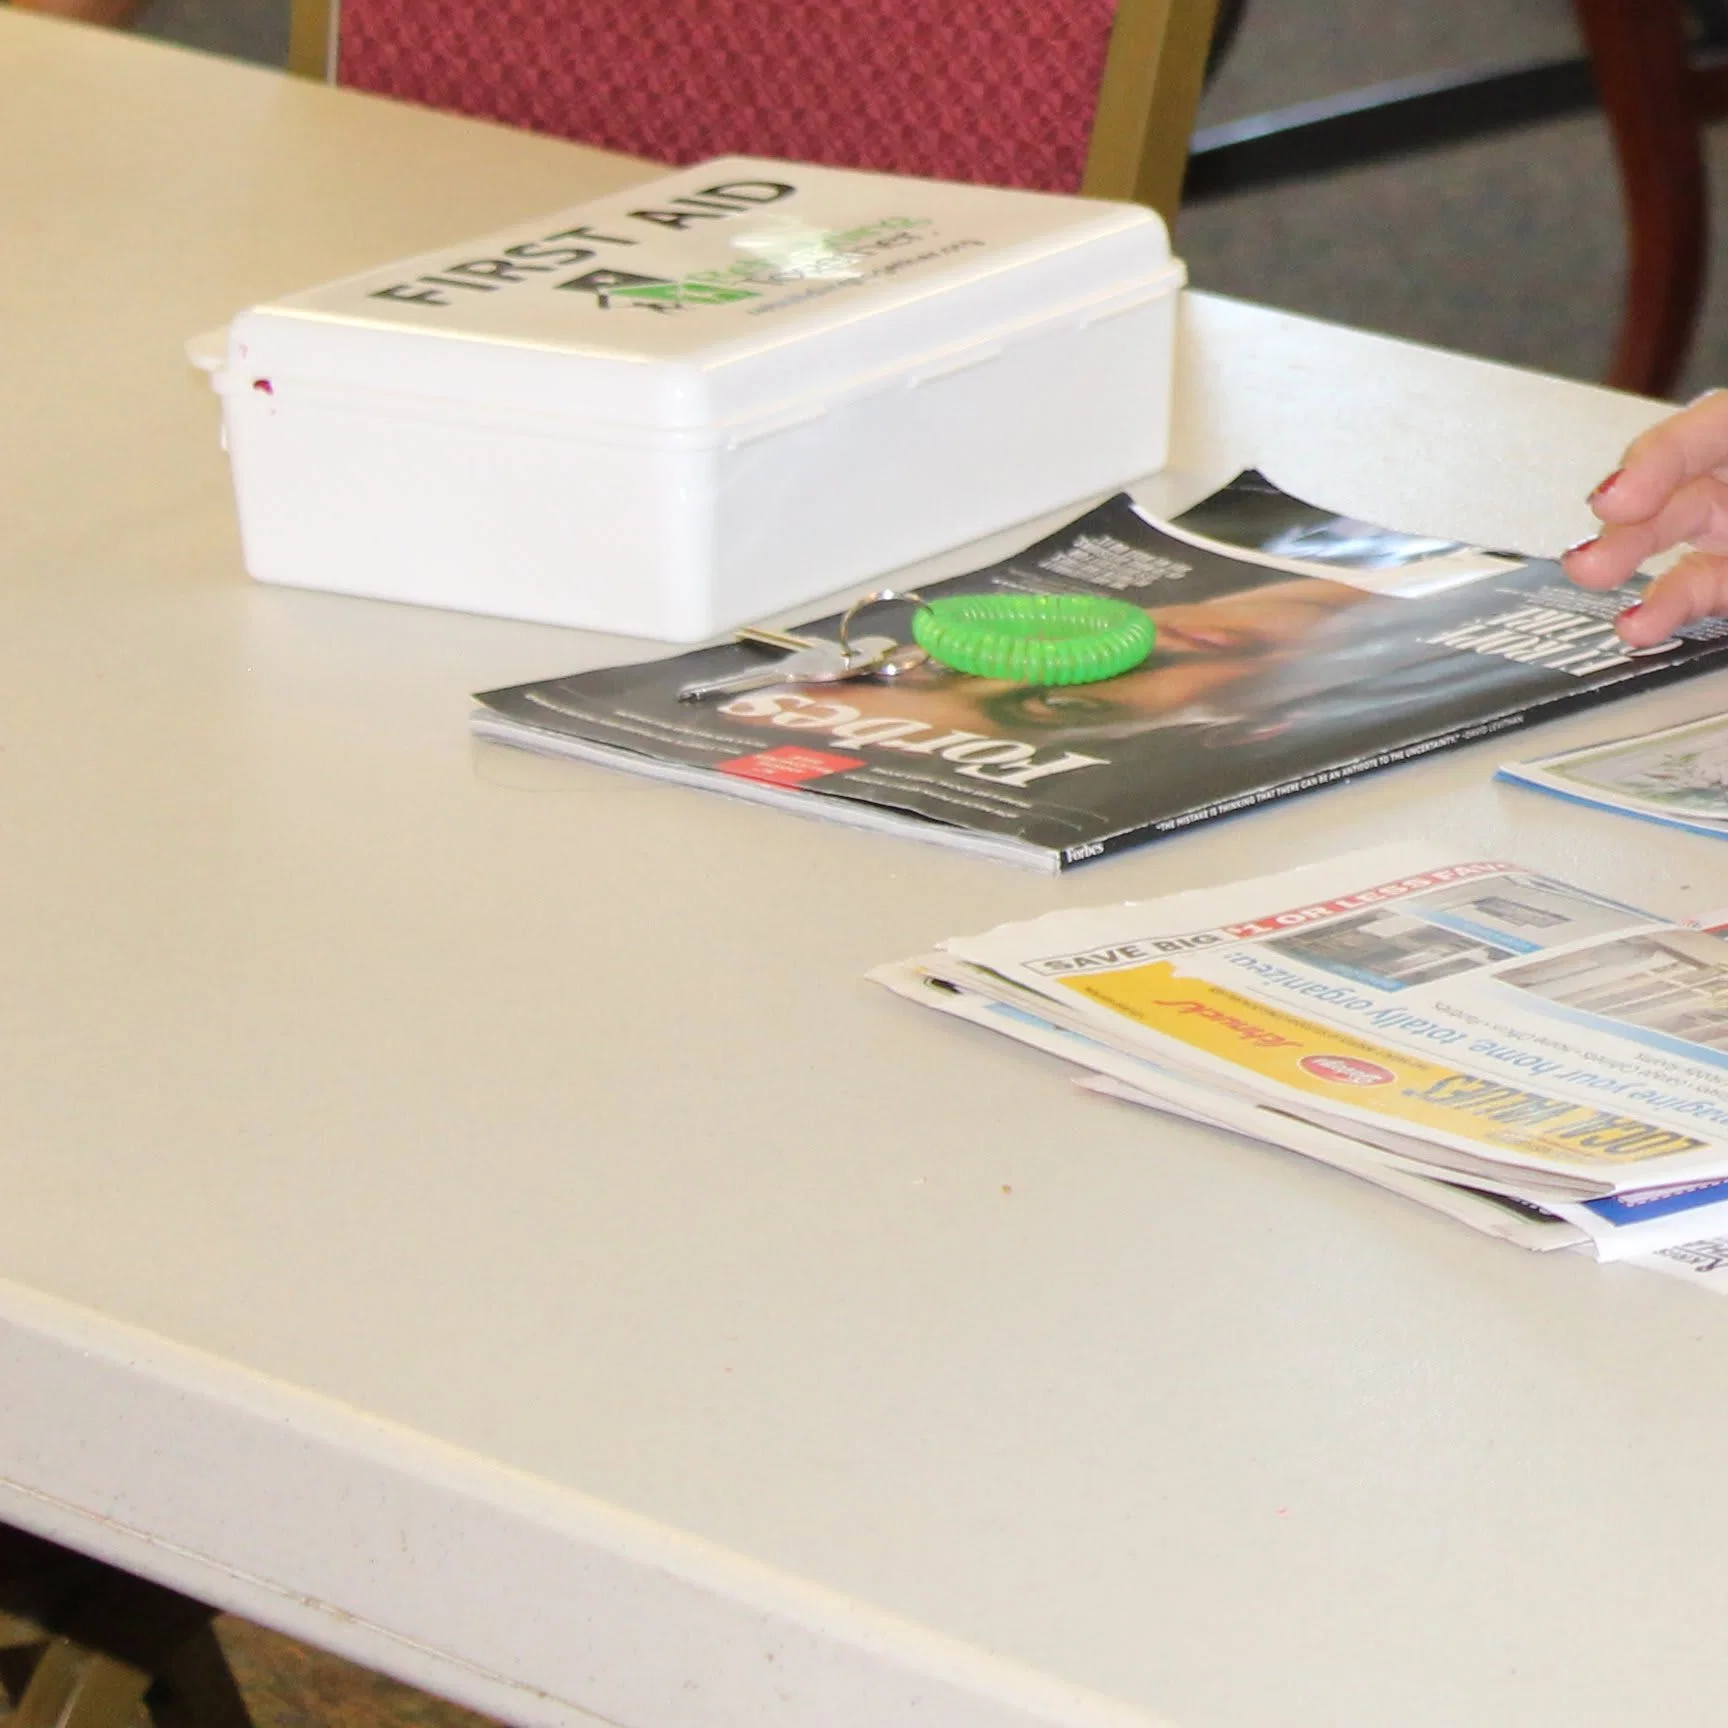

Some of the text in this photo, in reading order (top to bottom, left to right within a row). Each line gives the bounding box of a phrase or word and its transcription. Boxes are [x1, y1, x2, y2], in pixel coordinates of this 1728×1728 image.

[369, 179, 796, 307] FIRST AID
[716, 692, 1111, 788] Forbes
[1176, 809, 1207, 827] MISTAKE
[1210, 806, 1217, 817] IS
[1218, 794, 1254, 815] THINKING
[1257, 788, 1275, 803] THAT
[1276, 781, 1298, 797] THERE
[1300, 775, 1316, 790] CAN
[1318, 772, 1327, 784] BE
[1329, 768, 1340, 781] AN
[1342, 756, 1378, 777] ANTIDOTE
[1379, 753, 1388, 766] TO
[1391, 749, 1403, 762] THE
[1065, 841, 1104, 864] Forbes
[1043, 943, 1147, 973] SAVE
[1158, 930, 1222, 953] BIG
[1275, 906, 1333, 926] OR
[1339, 875, 1431, 910] LESS
[1362, 1007, 1468, 1044] totally
[1404, 1074, 1577, 1125] VALUES
[1554, 1069, 1643, 1093] your
[1549, 1110, 1708, 1161] LOCAL
